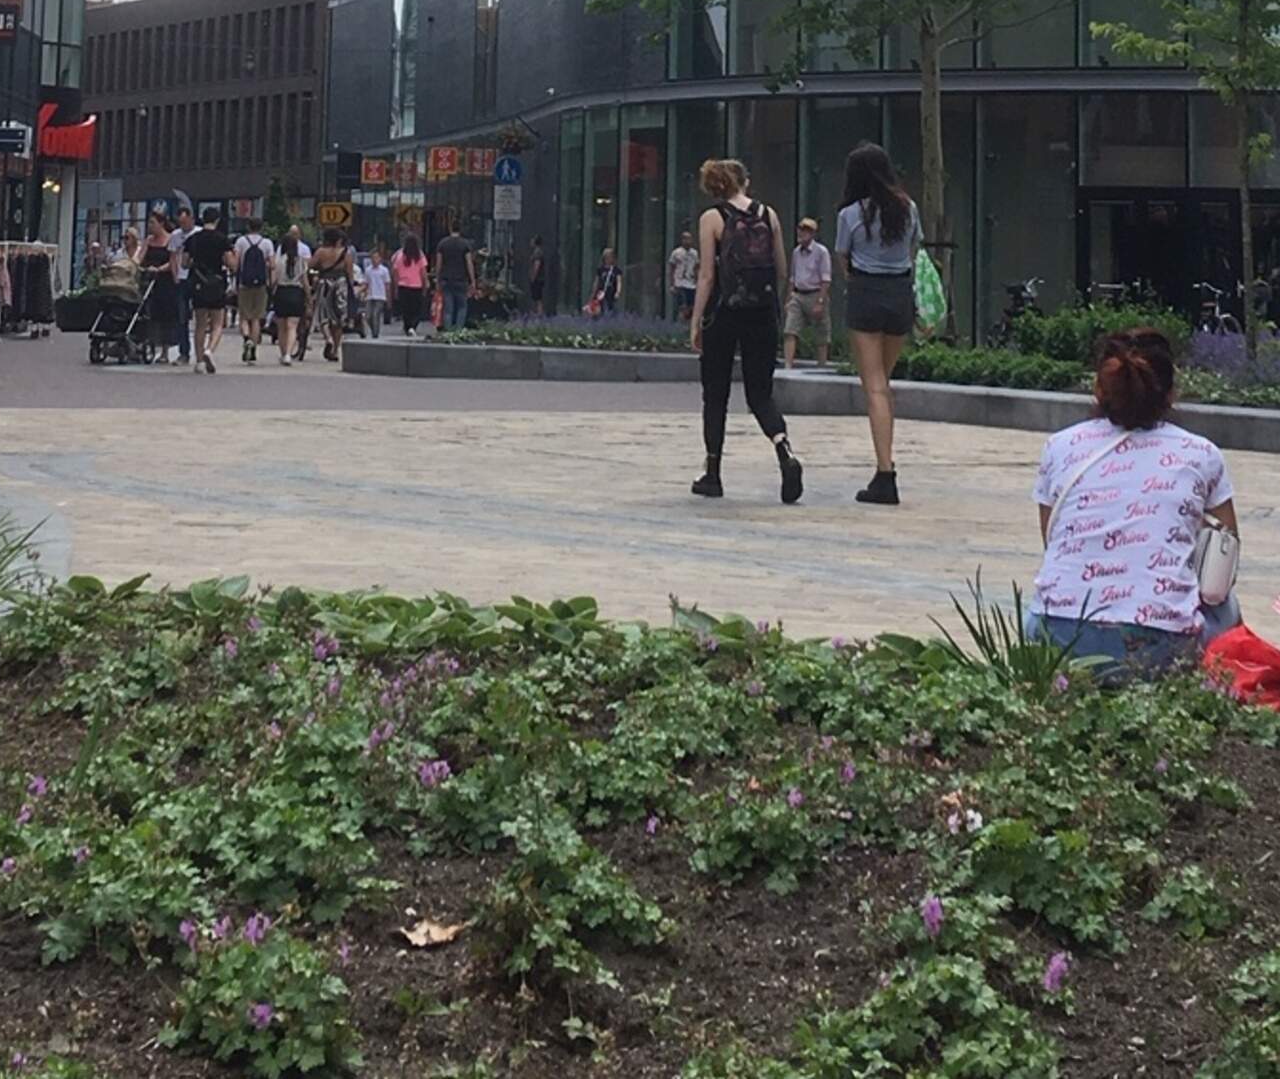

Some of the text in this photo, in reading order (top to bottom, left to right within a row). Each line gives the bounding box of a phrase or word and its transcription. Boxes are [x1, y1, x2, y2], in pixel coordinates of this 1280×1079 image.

[1141, 475, 1177, 494] Just
[1124, 500, 1161, 520] Just
[1103, 529, 1150, 550] Shine
[1081, 561, 1130, 582] Shine
